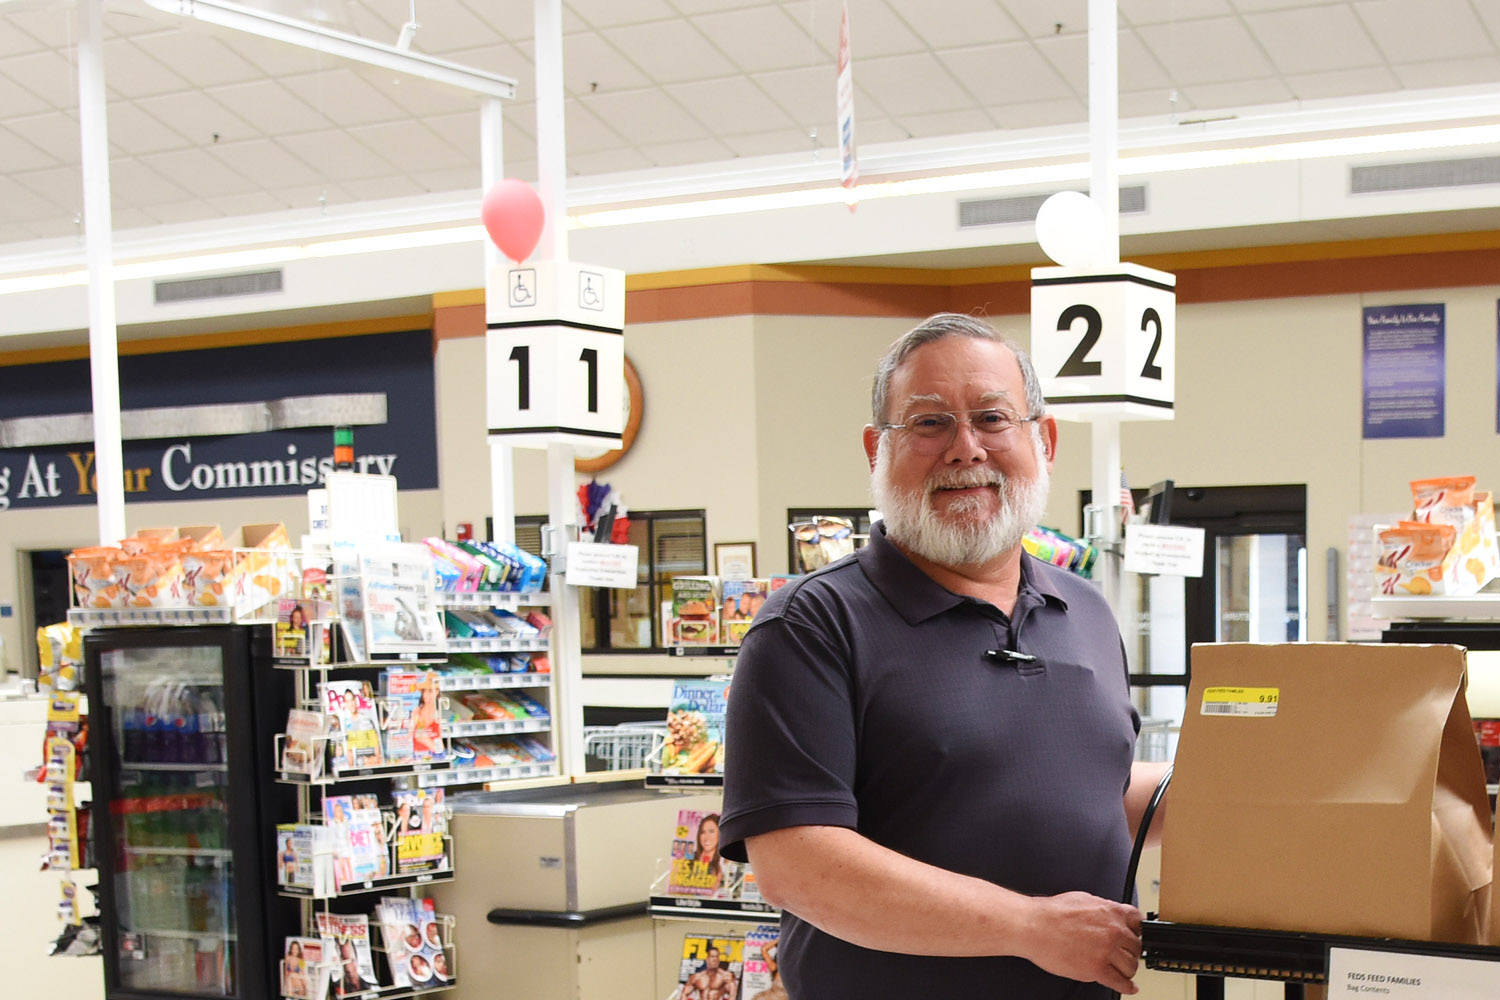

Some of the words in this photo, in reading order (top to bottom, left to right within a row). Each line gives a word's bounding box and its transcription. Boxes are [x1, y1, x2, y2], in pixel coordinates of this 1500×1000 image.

[1056, 304, 1102, 378] 2
[1140, 307, 1162, 381] 2
[508, 345, 531, 410] 1
[578, 347, 598, 413] 1
[18, 454, 62, 499] At
[66, 451, 153, 496] Yr
[161, 442, 397, 492] Commissry
[674, 685, 716, 700] Dinner
[1259, 695, 1278, 704] 9.91
[688, 699, 727, 713] Dollar
[683, 938, 745, 963] FLEX
[744, 961, 768, 973] SEX
[1347, 972, 1366, 981] FEDS
[1367, 973, 1385, 983] FEED
[1387, 975, 1421, 986] FAMILIES
[1347, 983, 1358, 992] Bag
[1360, 985, 1390, 994] Contents
